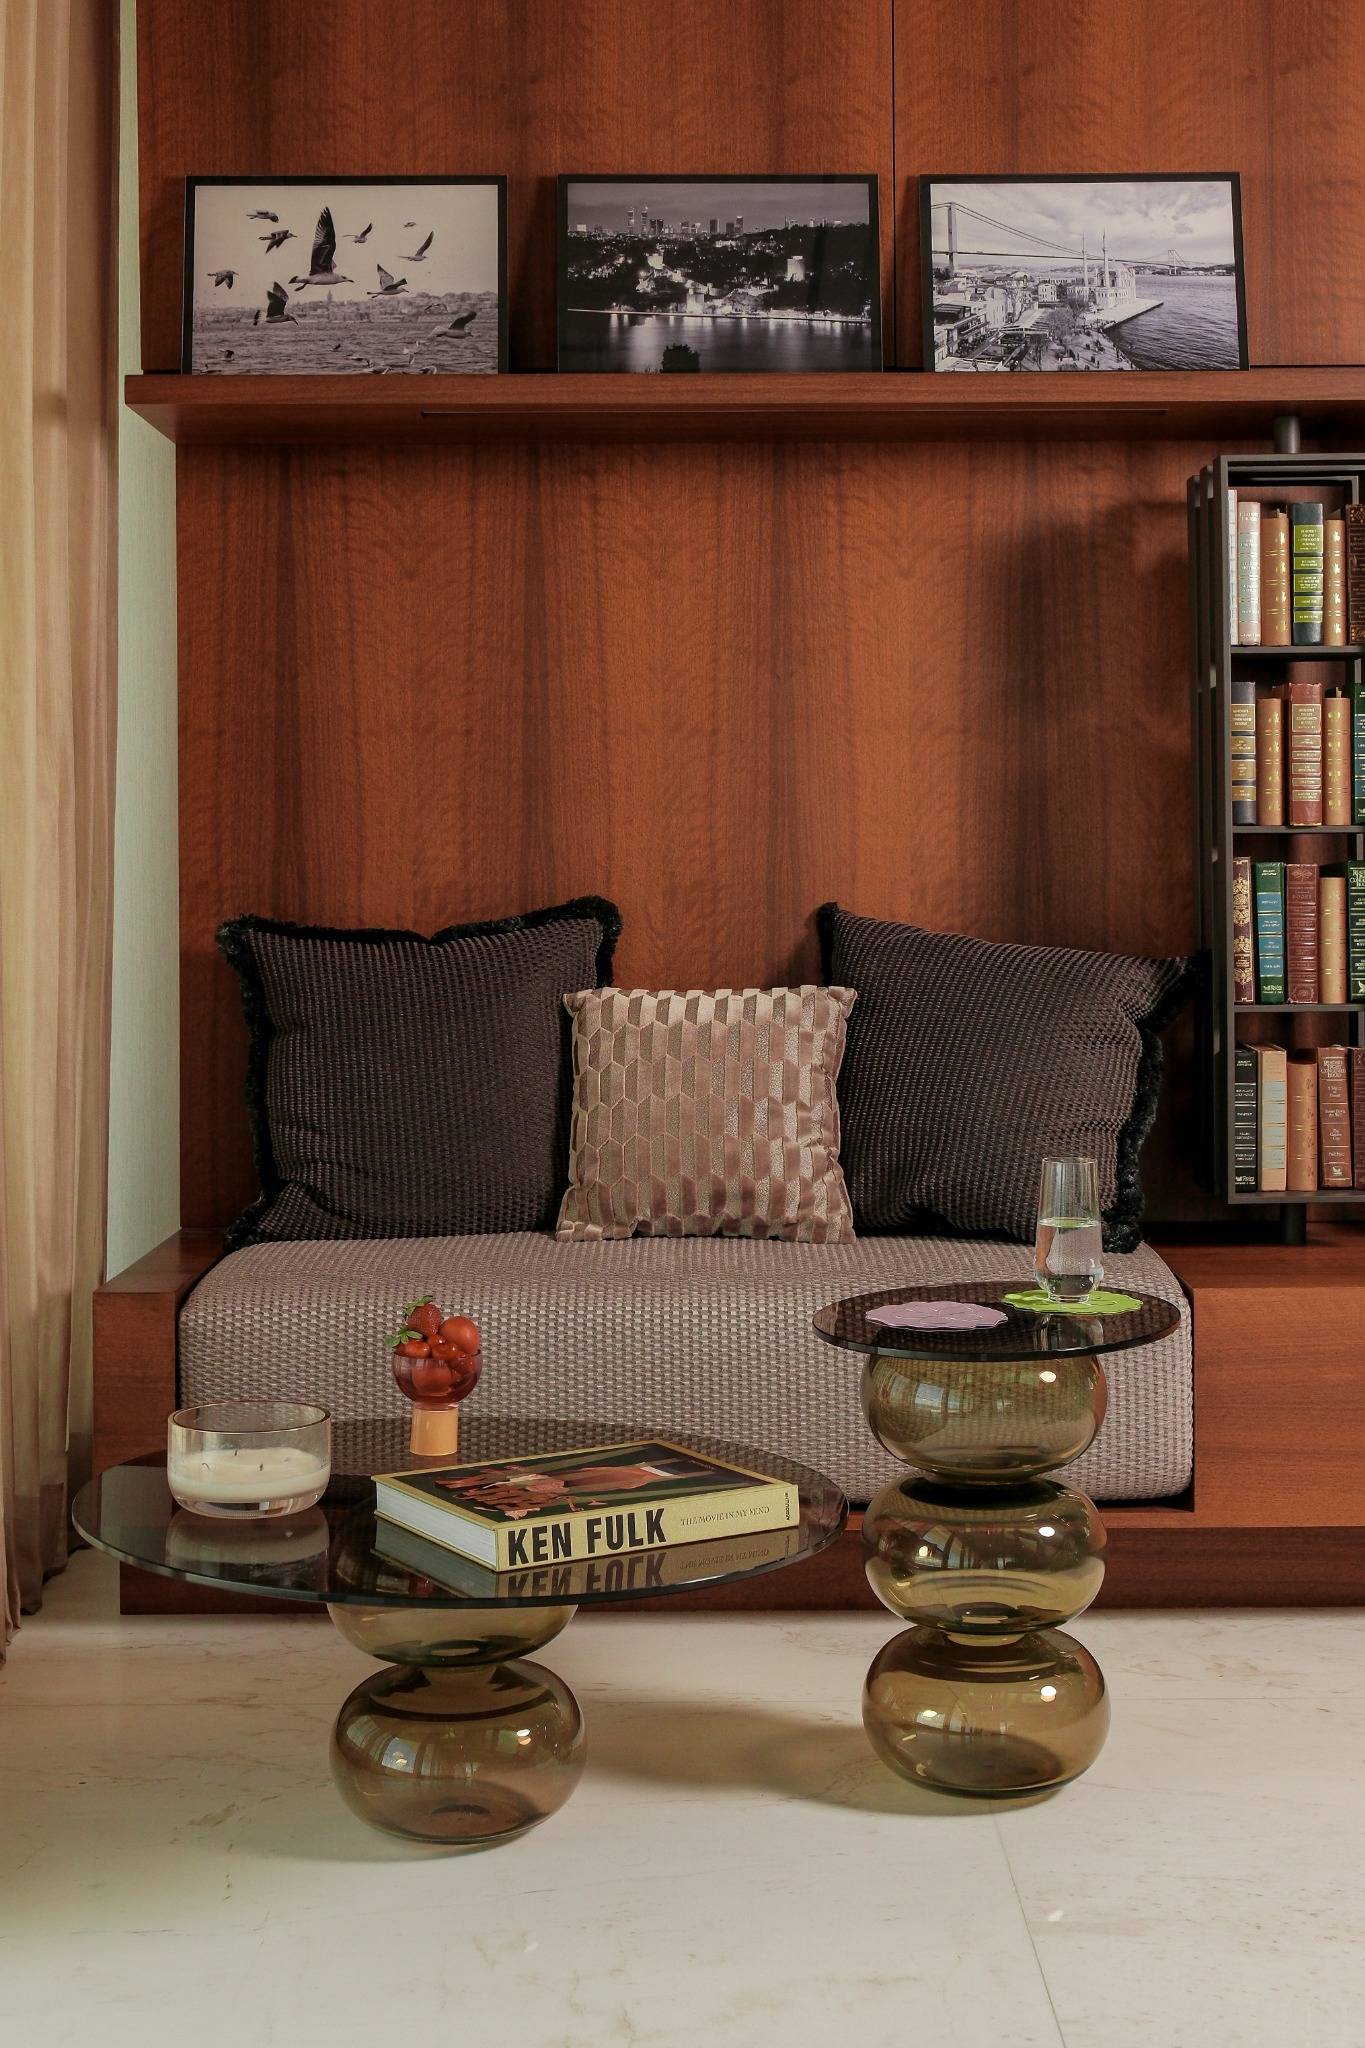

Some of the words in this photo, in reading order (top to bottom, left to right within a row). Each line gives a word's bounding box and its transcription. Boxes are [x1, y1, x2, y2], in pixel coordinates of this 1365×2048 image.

[508, 1522, 572, 1566] KEN
[586, 1508, 666, 1554] FULK
[680, 1516, 698, 1526] THE
[699, 1512, 725, 1523] MOVIE
